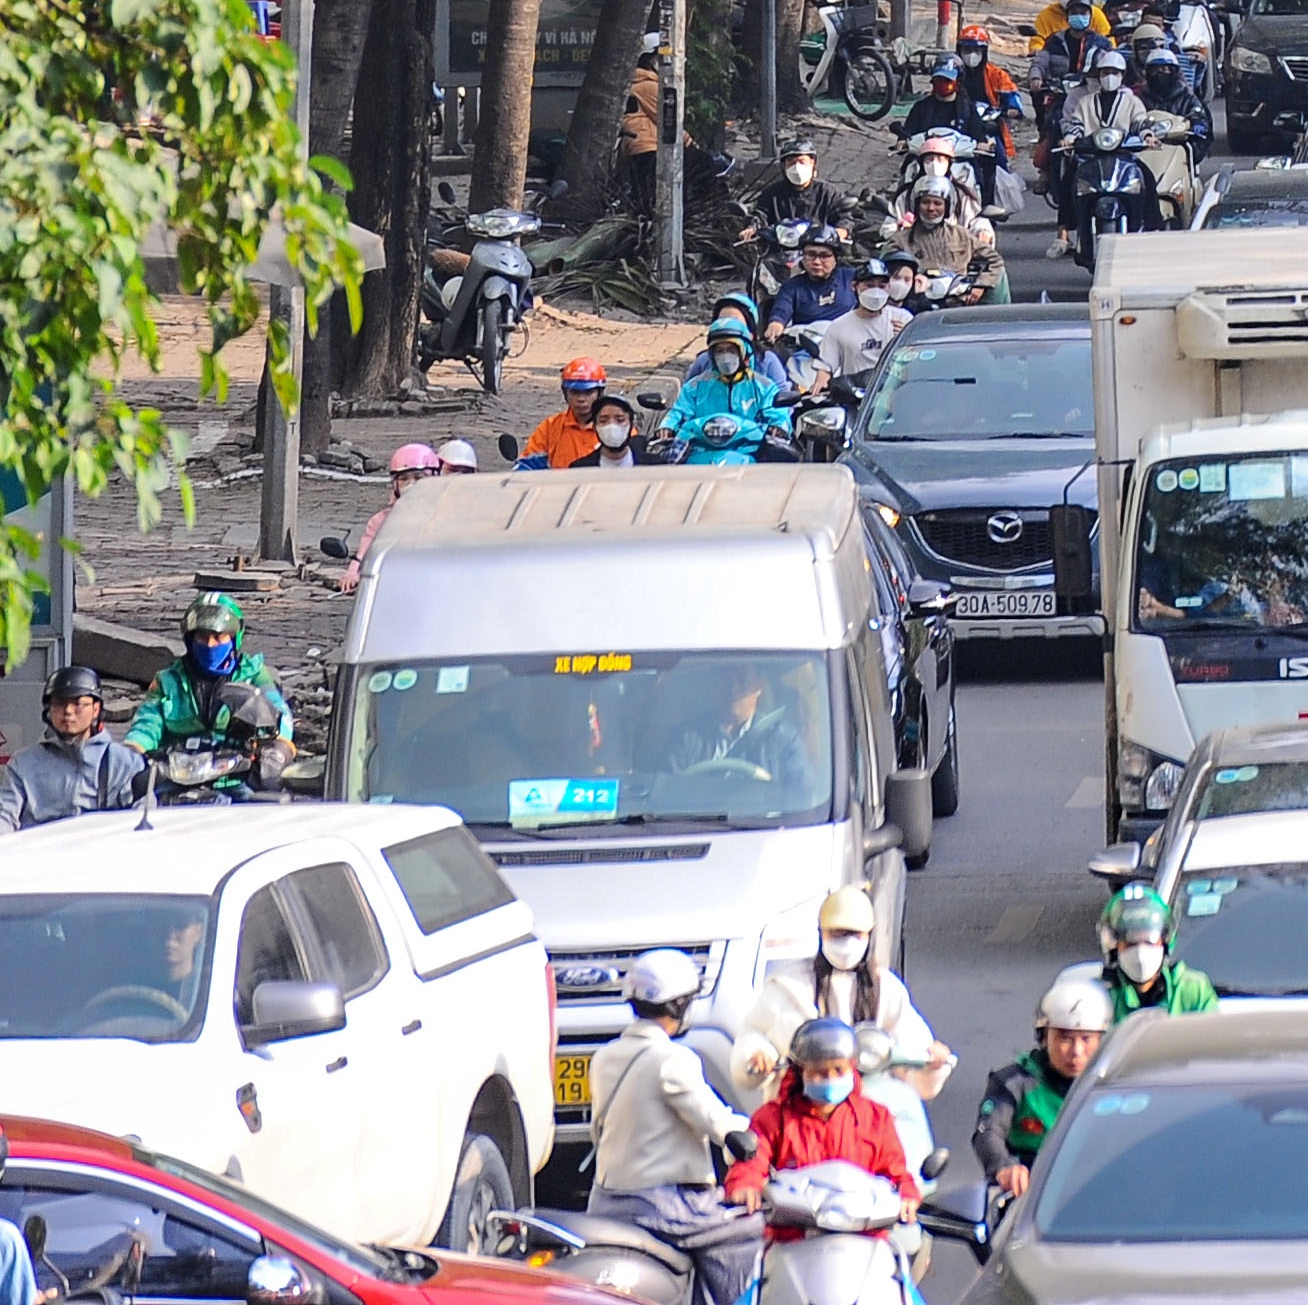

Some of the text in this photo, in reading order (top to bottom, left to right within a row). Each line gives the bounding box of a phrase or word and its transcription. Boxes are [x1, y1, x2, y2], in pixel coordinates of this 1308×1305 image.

[958, 595, 1054, 614] 30A-509.78
[555, 656, 571, 673] XE
[572, 787, 609, 804] 212
[562, 967, 602, 986] Ford
[559, 1059, 592, 1080] 29
